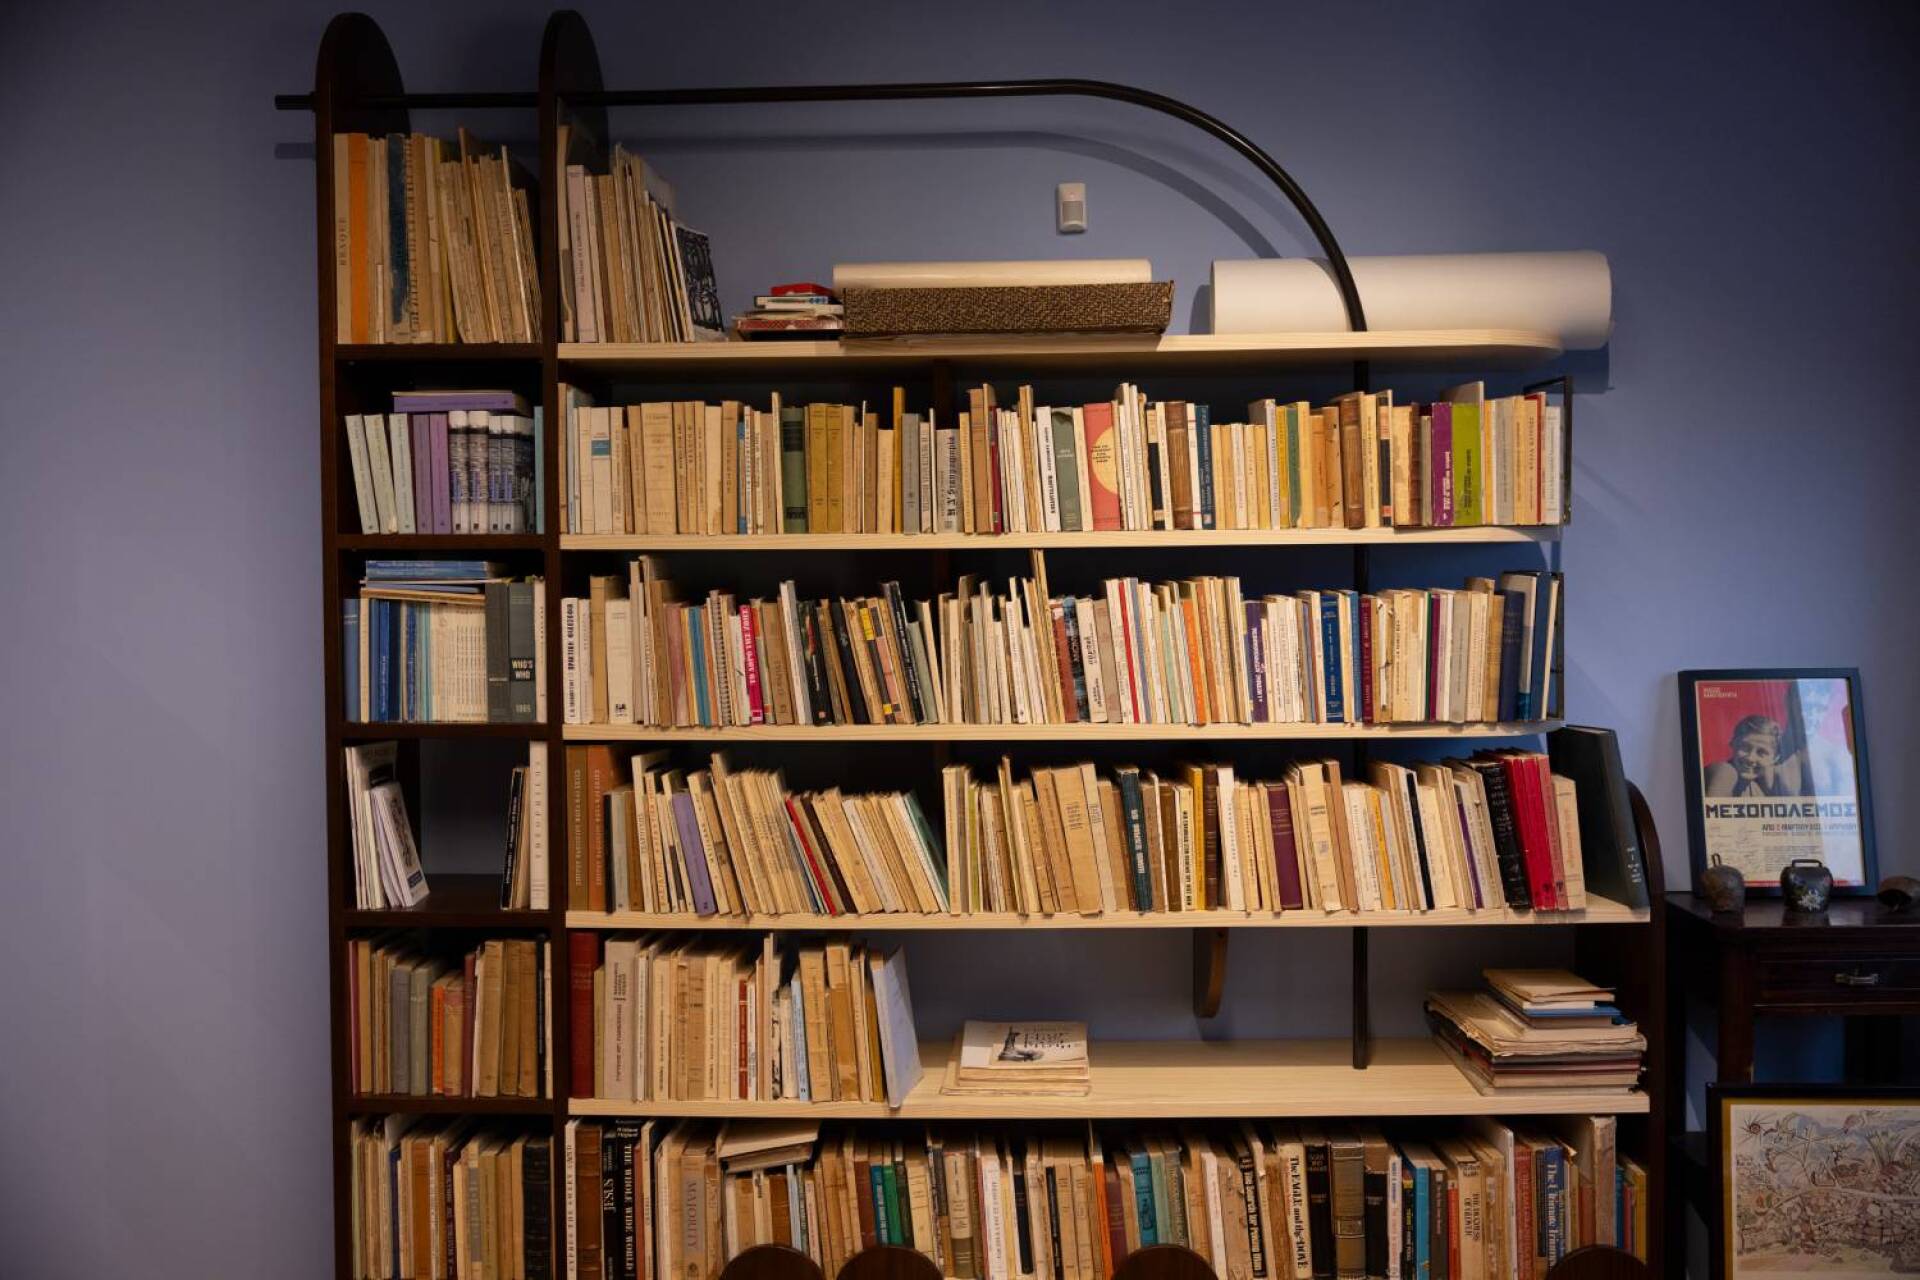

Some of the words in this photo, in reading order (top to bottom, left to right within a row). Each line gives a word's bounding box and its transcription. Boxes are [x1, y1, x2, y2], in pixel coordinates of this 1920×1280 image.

[511, 660, 534, 670] WHO'S
[515, 670, 531, 680] WHO
[624, 1144, 632, 1165] THE
[1290, 1156, 1300, 1173] The
[1547, 1162, 1558, 1181] The
[624, 1167, 632, 1201] WHOLE
[603, 1178, 616, 1213] JESUS
[624, 1206, 633, 1234] WIDE
[686, 1180, 698, 1249] MAJORITY
[1293, 1208, 1304, 1225] and
[1294, 1224, 1305, 1238] the
[625, 1235, 633, 1271] WORLD
